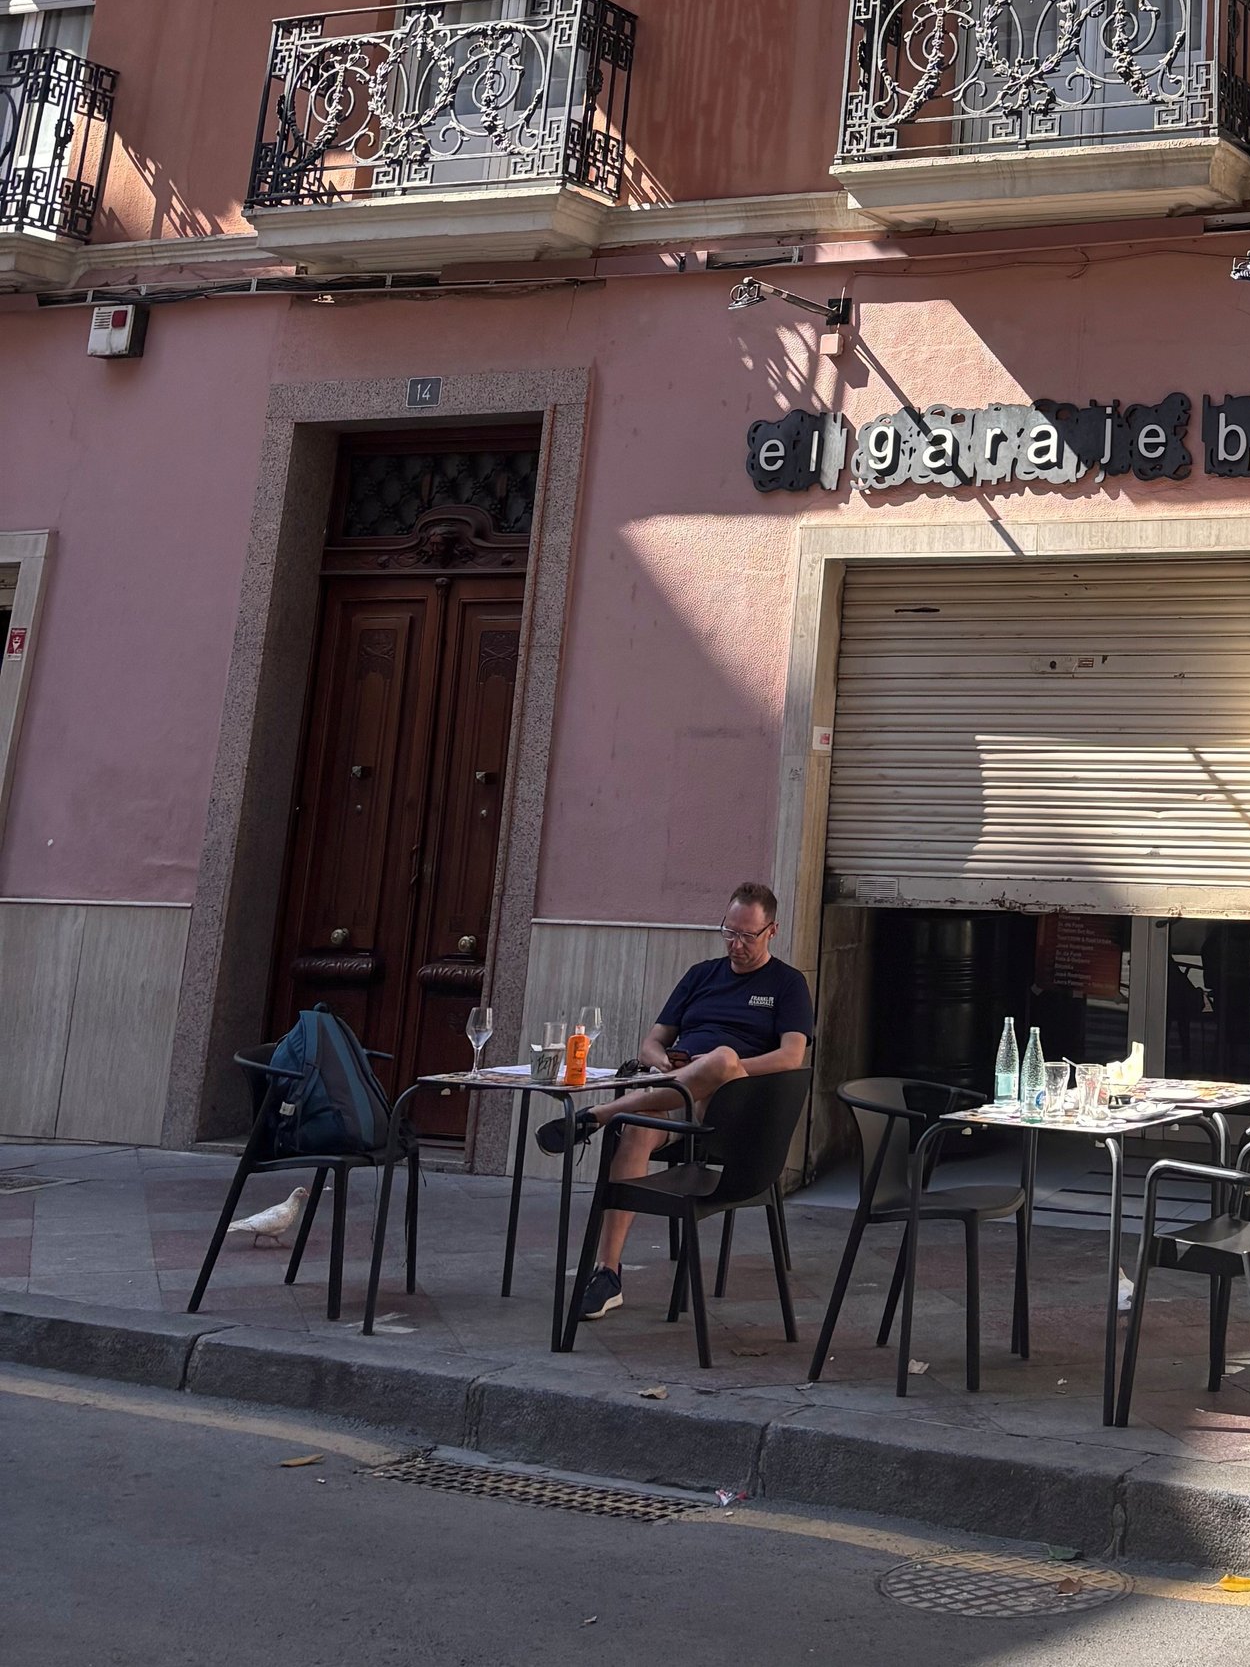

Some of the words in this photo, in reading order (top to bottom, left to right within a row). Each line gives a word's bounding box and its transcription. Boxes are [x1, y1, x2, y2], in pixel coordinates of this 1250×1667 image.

[416, 383, 431, 402] 14
[759, 429, 819, 471] el
[868, 406, 1167, 470] garaje
